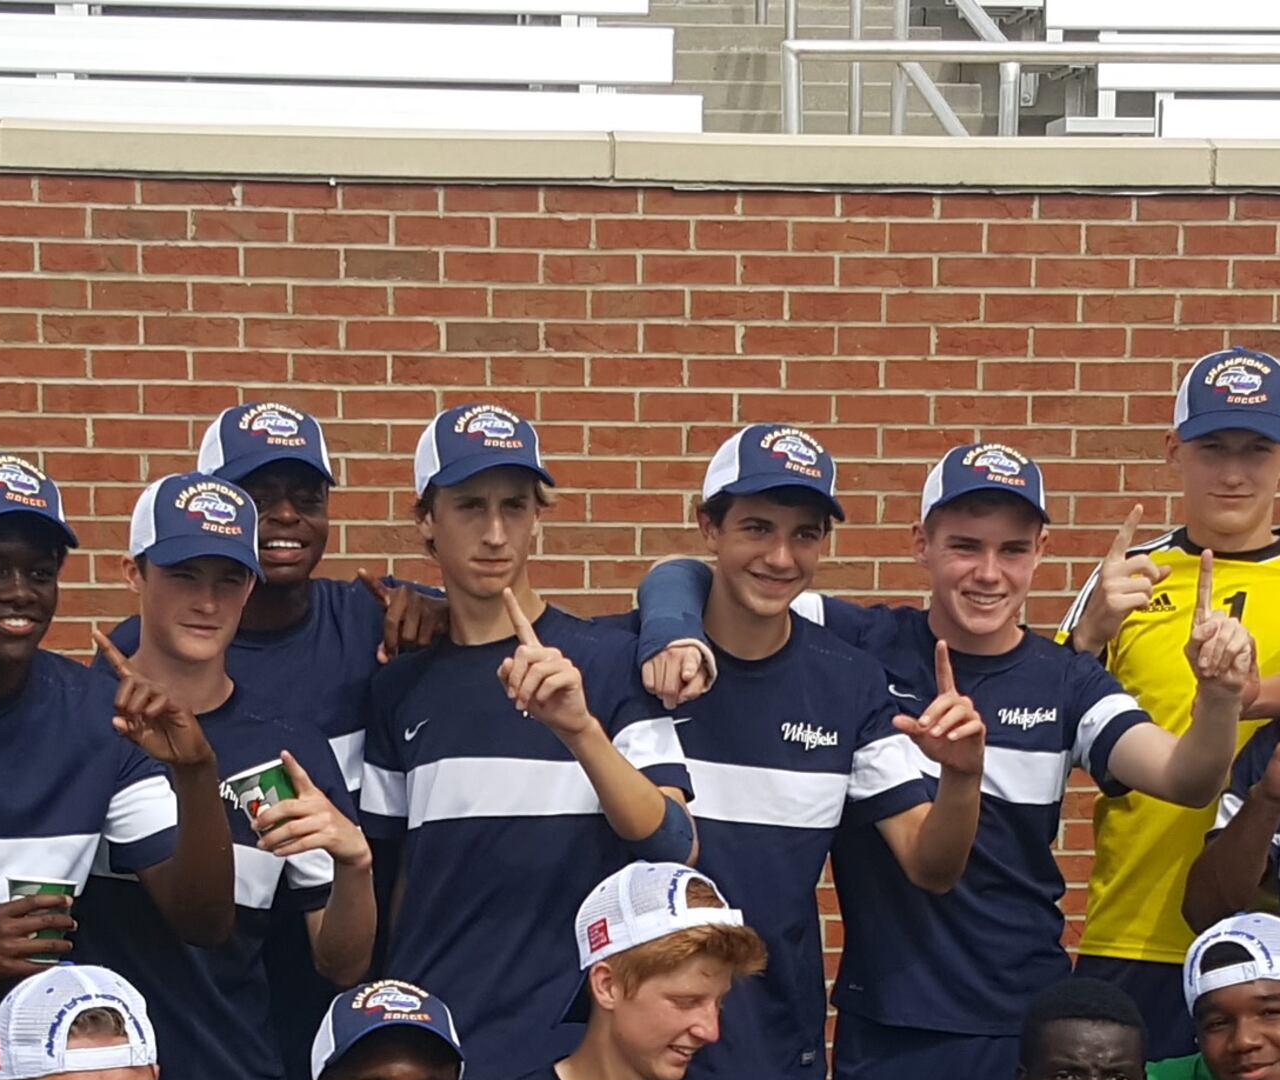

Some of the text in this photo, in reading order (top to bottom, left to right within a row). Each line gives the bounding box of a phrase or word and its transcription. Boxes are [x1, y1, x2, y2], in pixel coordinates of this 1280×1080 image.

[1205, 357, 1272, 385] CHAMPIONS
[1227, 394, 1268, 403] SOCCER
[239, 402, 304, 430] CHAMPIONS
[455, 405, 519, 433] CHAMPIONS
[761, 428, 824, 454] CHAMPIONS
[963, 443, 1028, 465] CHAMPIONS
[5, 491, 47, 507] SOCCER
[175, 481, 244, 509] CHAMPIONS
[201, 522, 243, 535] SOCCER
[1223, 591, 1247, 622] 1
[999, 707, 1056, 730] Whitefield
[782, 722, 837, 750] Whitefield
[352, 980, 429, 1009] CHAMPIONS
